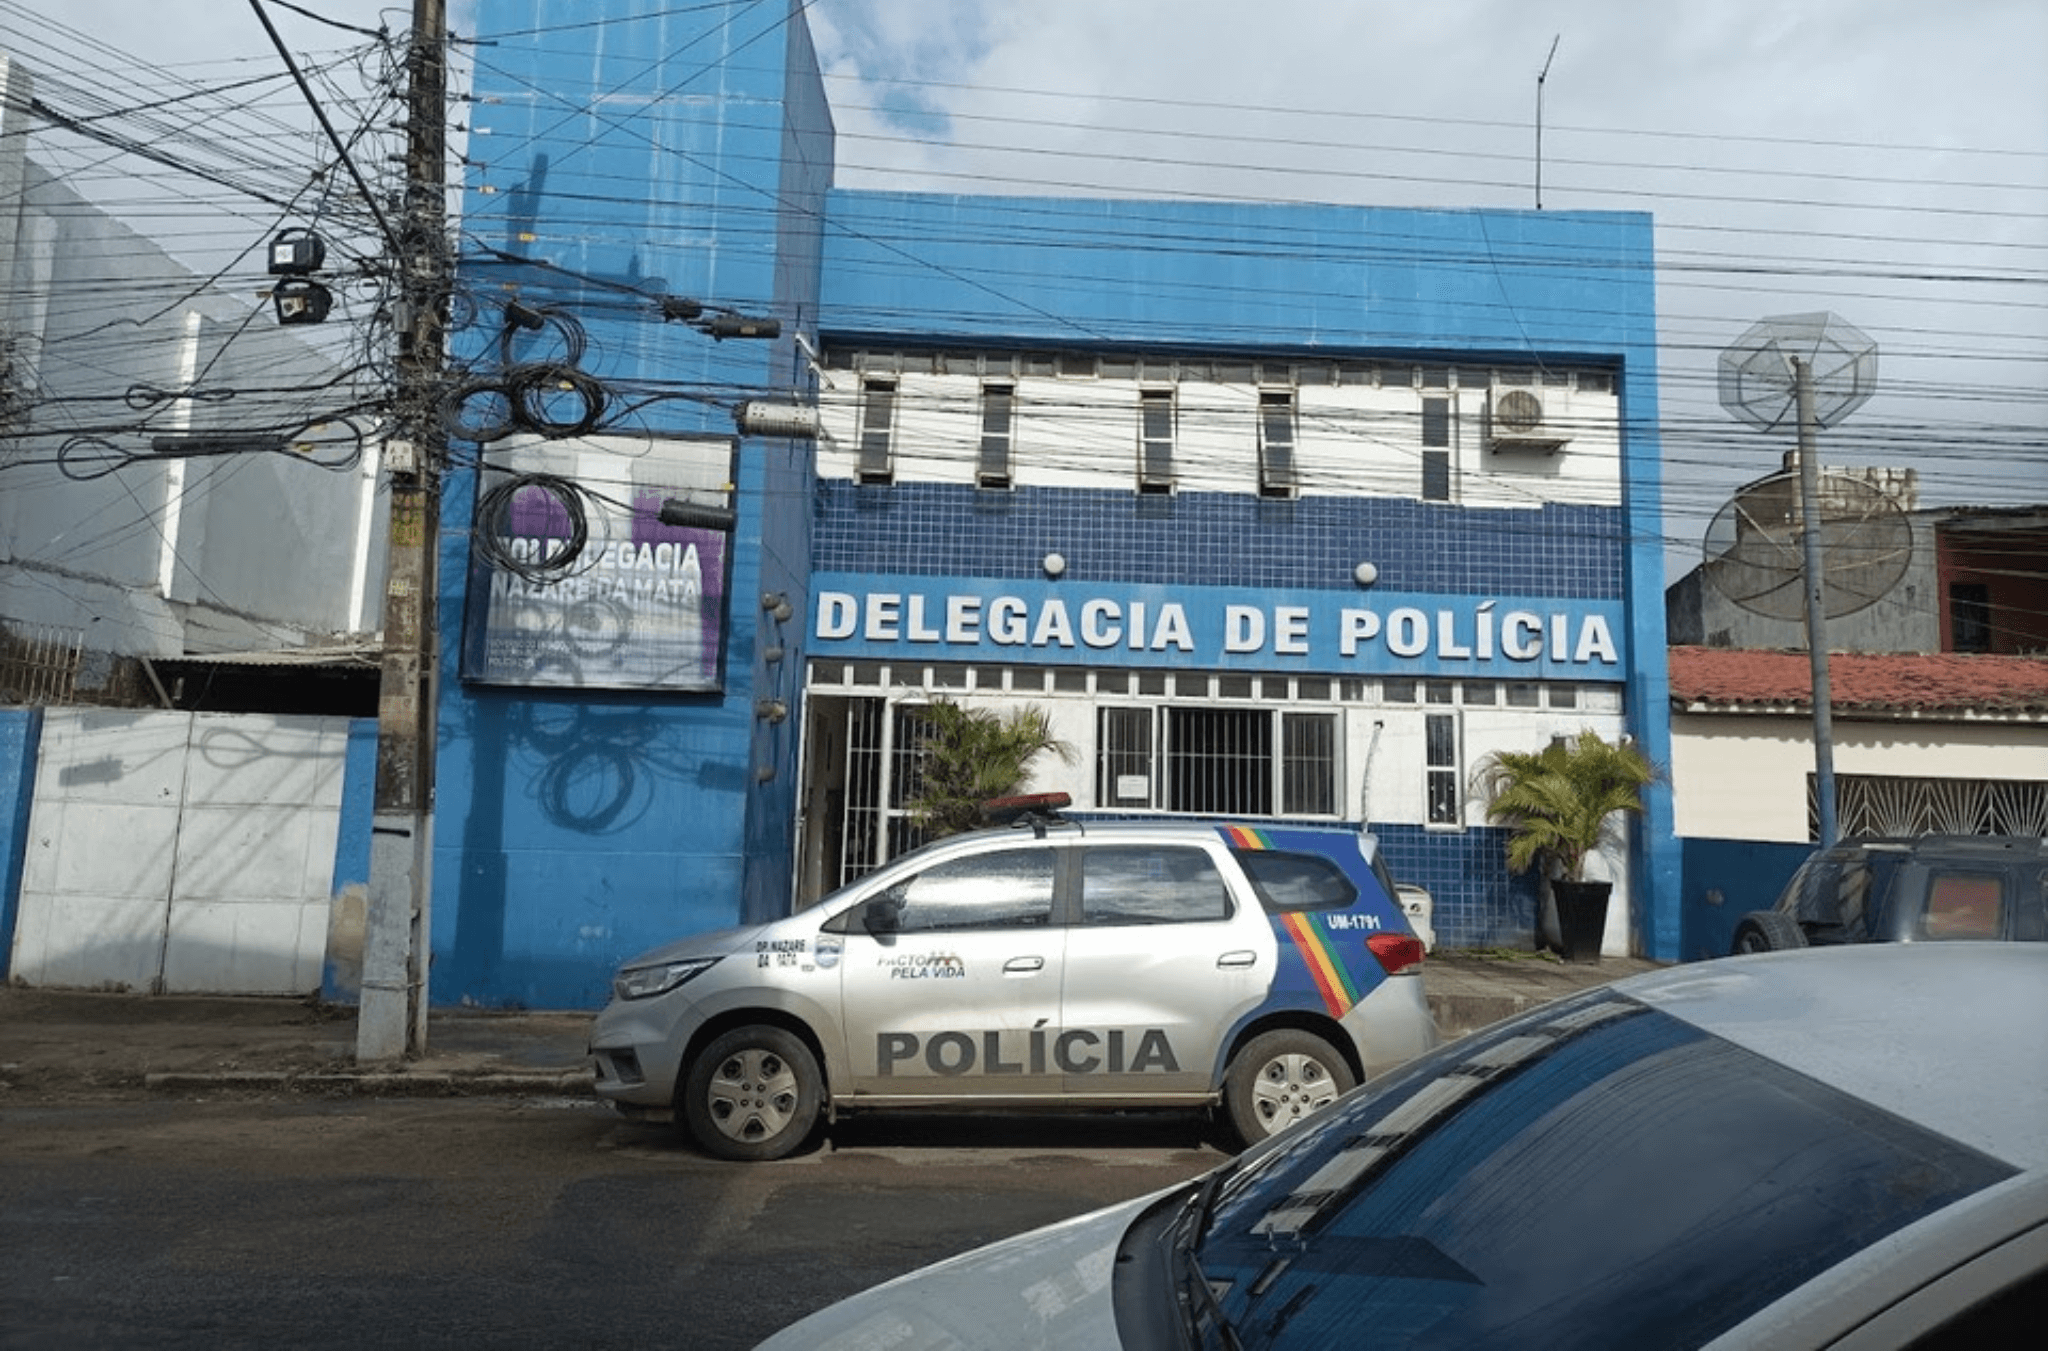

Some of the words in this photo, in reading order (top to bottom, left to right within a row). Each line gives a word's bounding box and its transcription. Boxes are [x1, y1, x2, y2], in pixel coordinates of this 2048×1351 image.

[545, 537, 701, 575] DLEGACIA
[597, 576, 628, 602] DA
[634, 578, 697, 604] MATA
[815, 590, 1195, 653] DELEGACIA
[1224, 604, 1310, 656] DE
[1339, 600, 1619, 666] POLÍCIA
[1327, 913, 1382, 930] UM-1791
[891, 966, 929, 979] PELA
[932, 966, 966, 979] VIDA
[876, 1017, 1181, 1077] POLÍCIA
